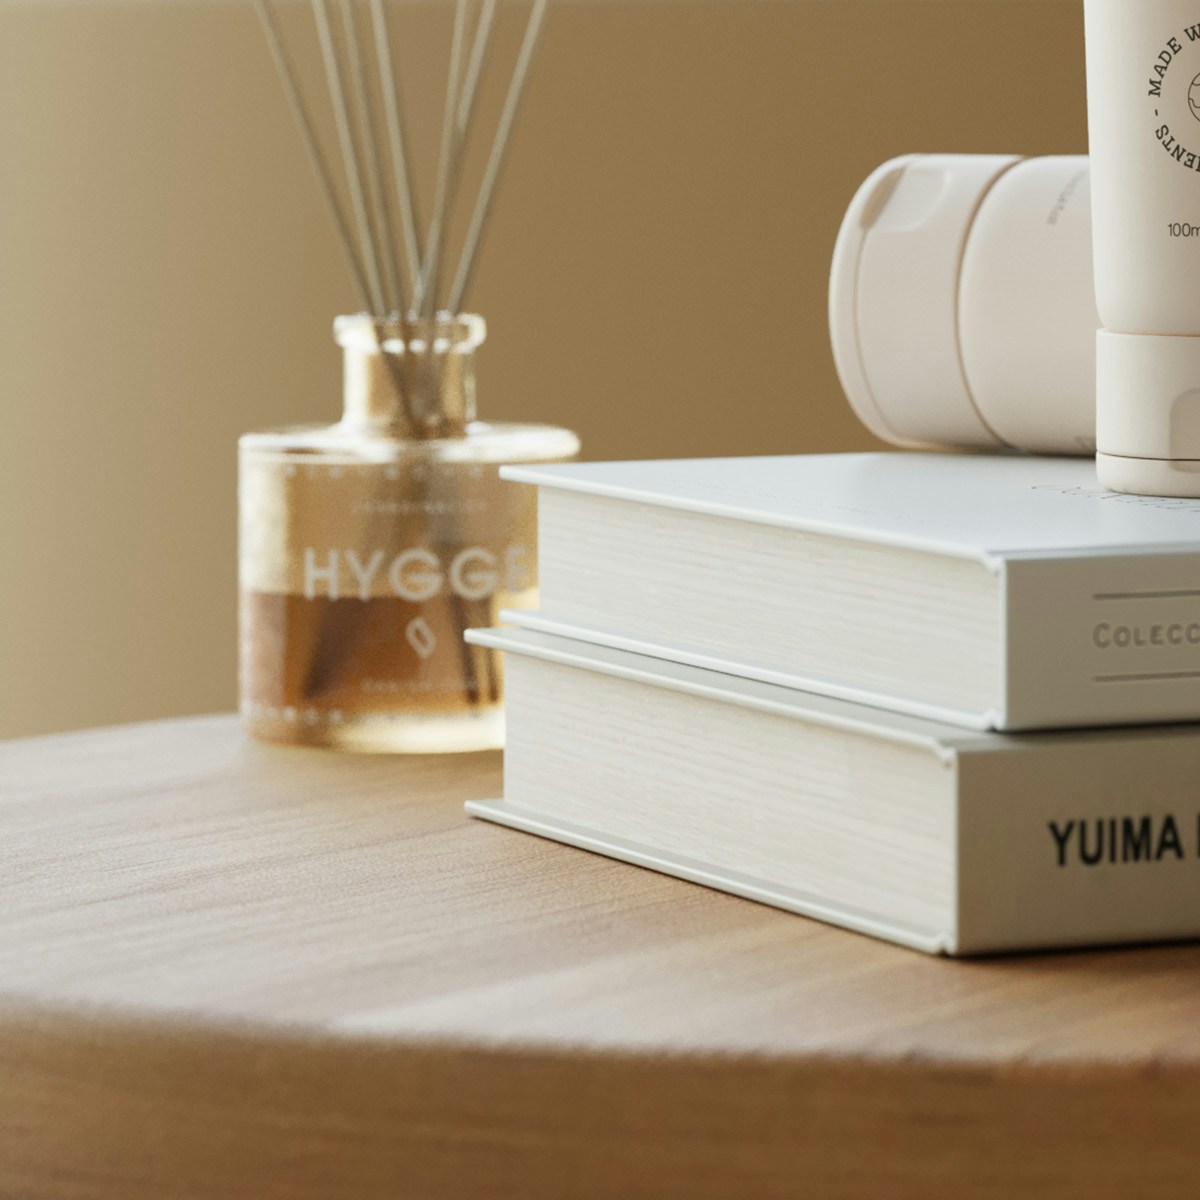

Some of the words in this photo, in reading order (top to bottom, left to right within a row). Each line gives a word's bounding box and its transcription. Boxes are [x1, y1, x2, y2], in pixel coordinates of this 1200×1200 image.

[1148, 37, 1182, 98] MADE
[303, 544, 528, 601] HYGGE
[1048, 813, 1184, 867] YUIMA
